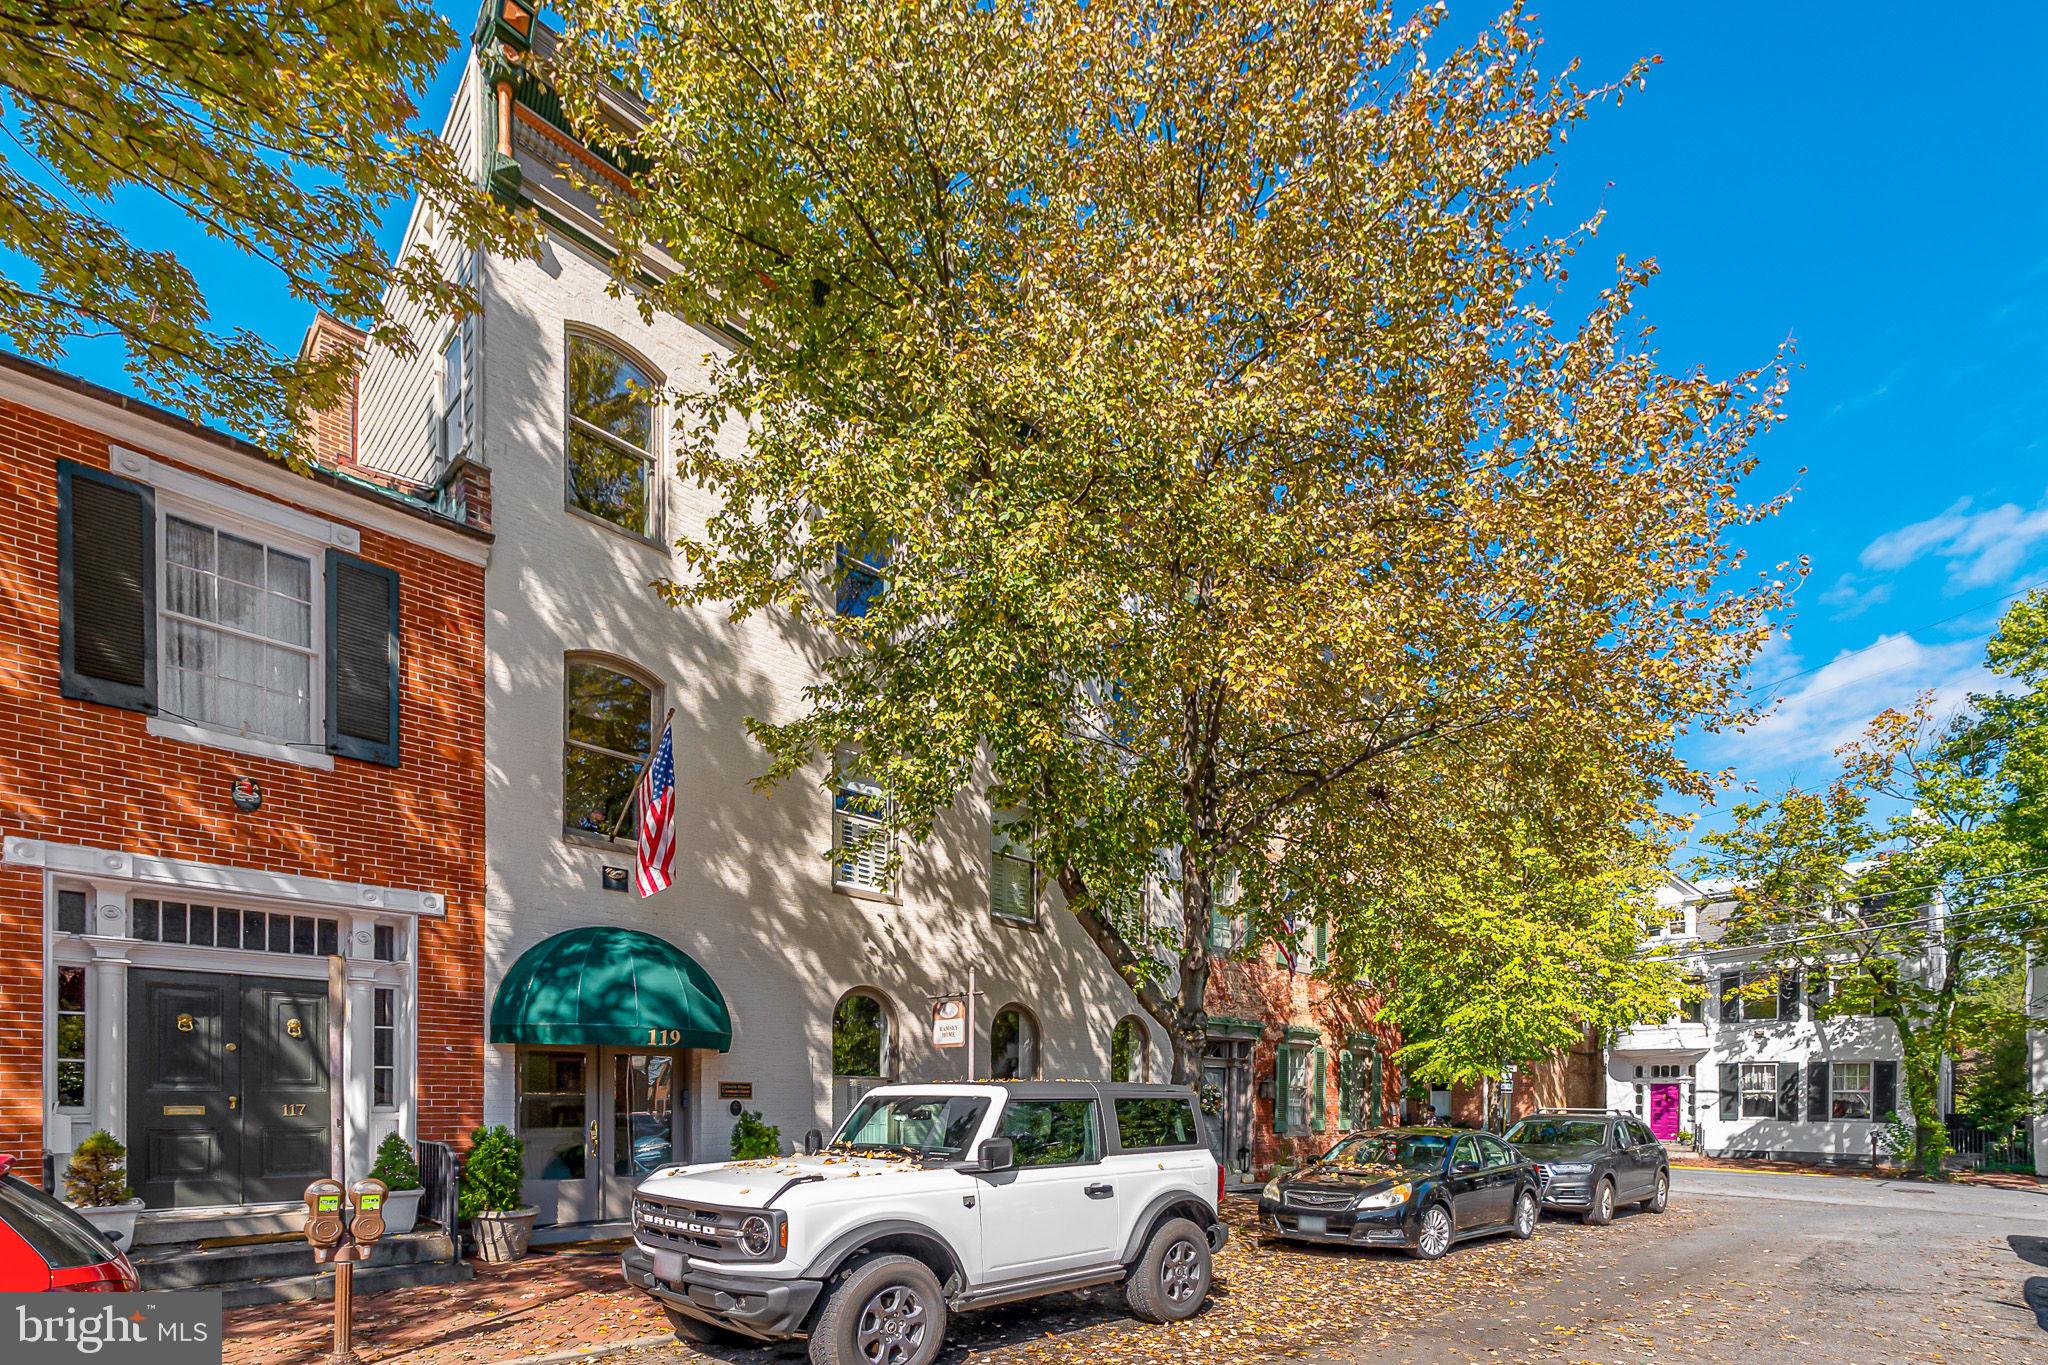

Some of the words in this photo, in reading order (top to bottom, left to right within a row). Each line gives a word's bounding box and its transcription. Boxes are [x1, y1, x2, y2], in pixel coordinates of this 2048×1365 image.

[647, 1028, 681, 1046] 119
[281, 1103, 307, 1117] 117
[643, 1214, 716, 1235] BRONCO
